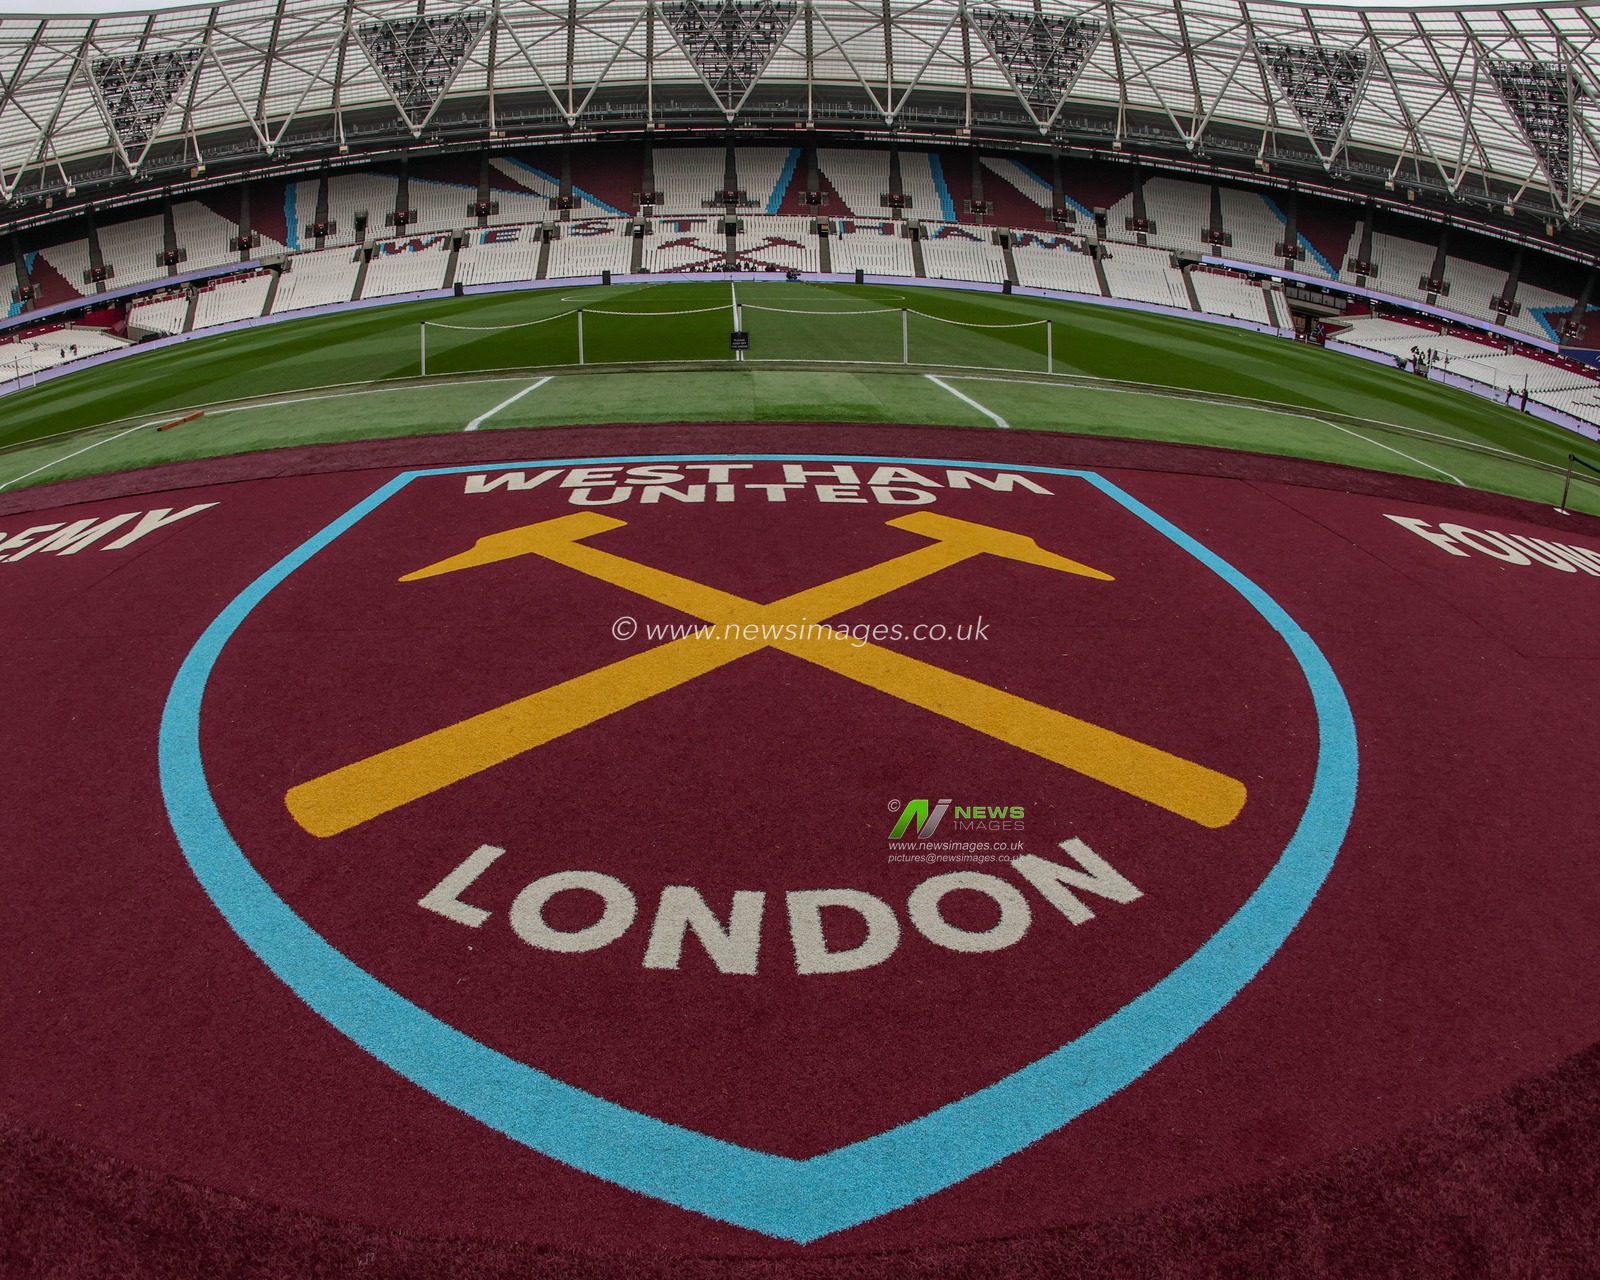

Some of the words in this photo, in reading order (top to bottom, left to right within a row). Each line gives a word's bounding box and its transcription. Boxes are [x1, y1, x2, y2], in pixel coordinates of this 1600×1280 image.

[464, 464, 753, 494] WEST
[783, 465, 1055, 496] HAM
[568, 484, 937, 506] UNITED
[0, 502, 221, 564] EMY
[417, 837, 1145, 976] LONDON
